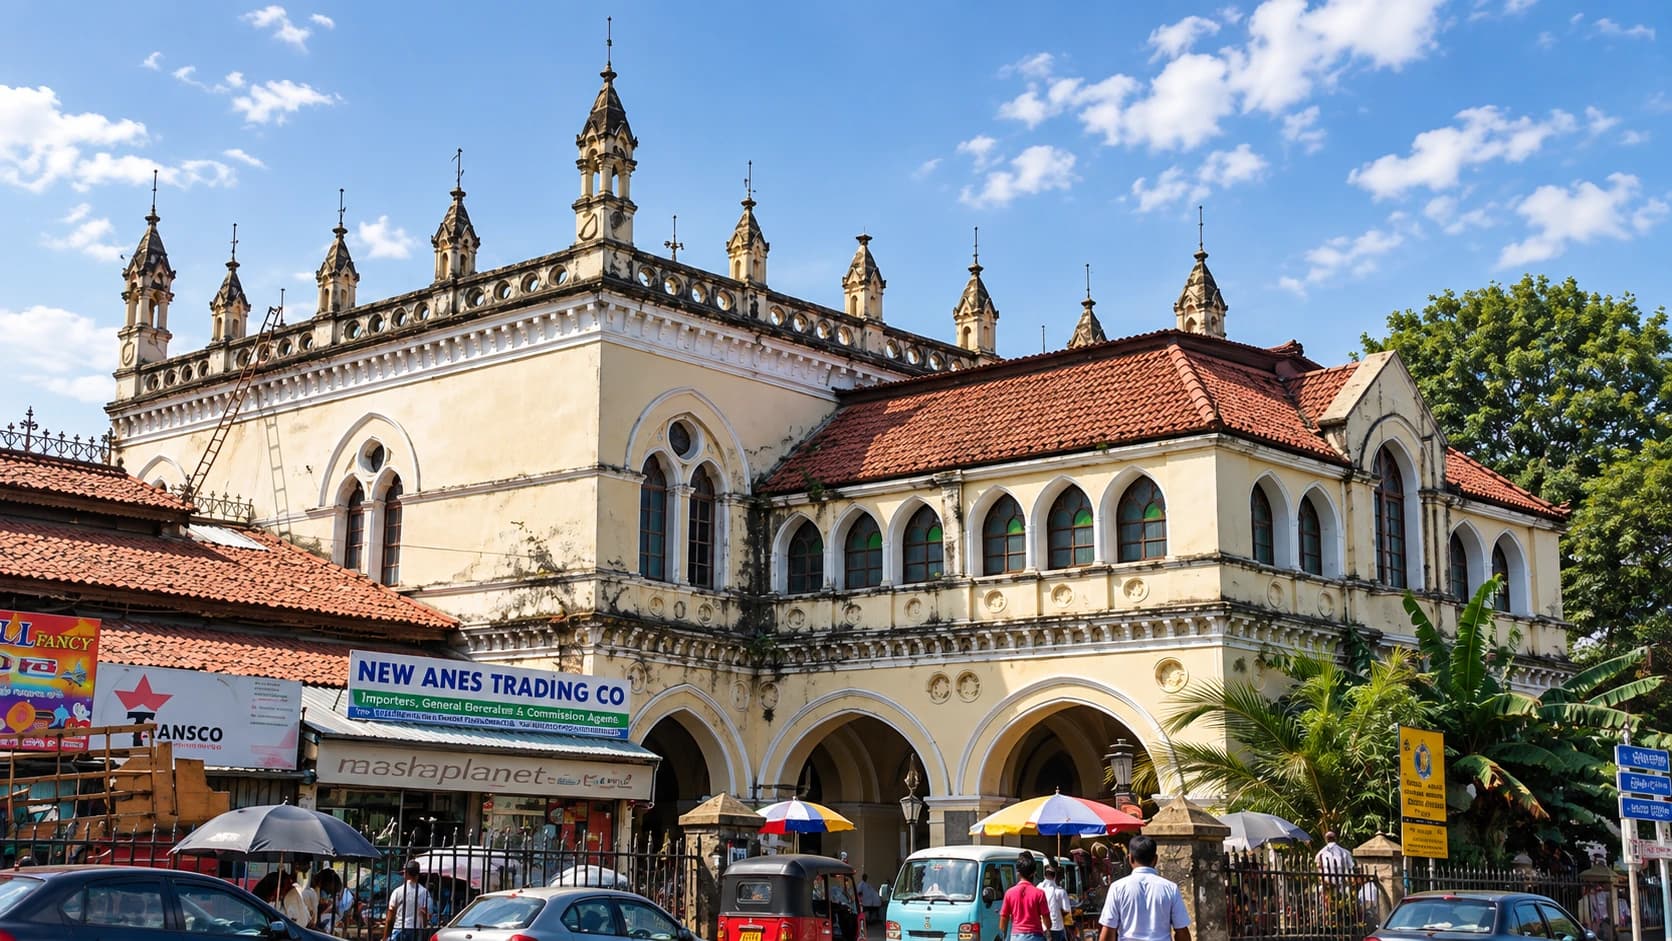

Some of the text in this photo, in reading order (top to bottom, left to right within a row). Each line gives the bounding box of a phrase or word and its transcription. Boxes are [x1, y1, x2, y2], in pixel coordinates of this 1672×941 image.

[37, 634, 94, 651] FANCY
[358, 660, 625, 706] NEW ANES TRADING CO
[422, 698, 462, 711] General
[527, 708, 585, 722] Commission
